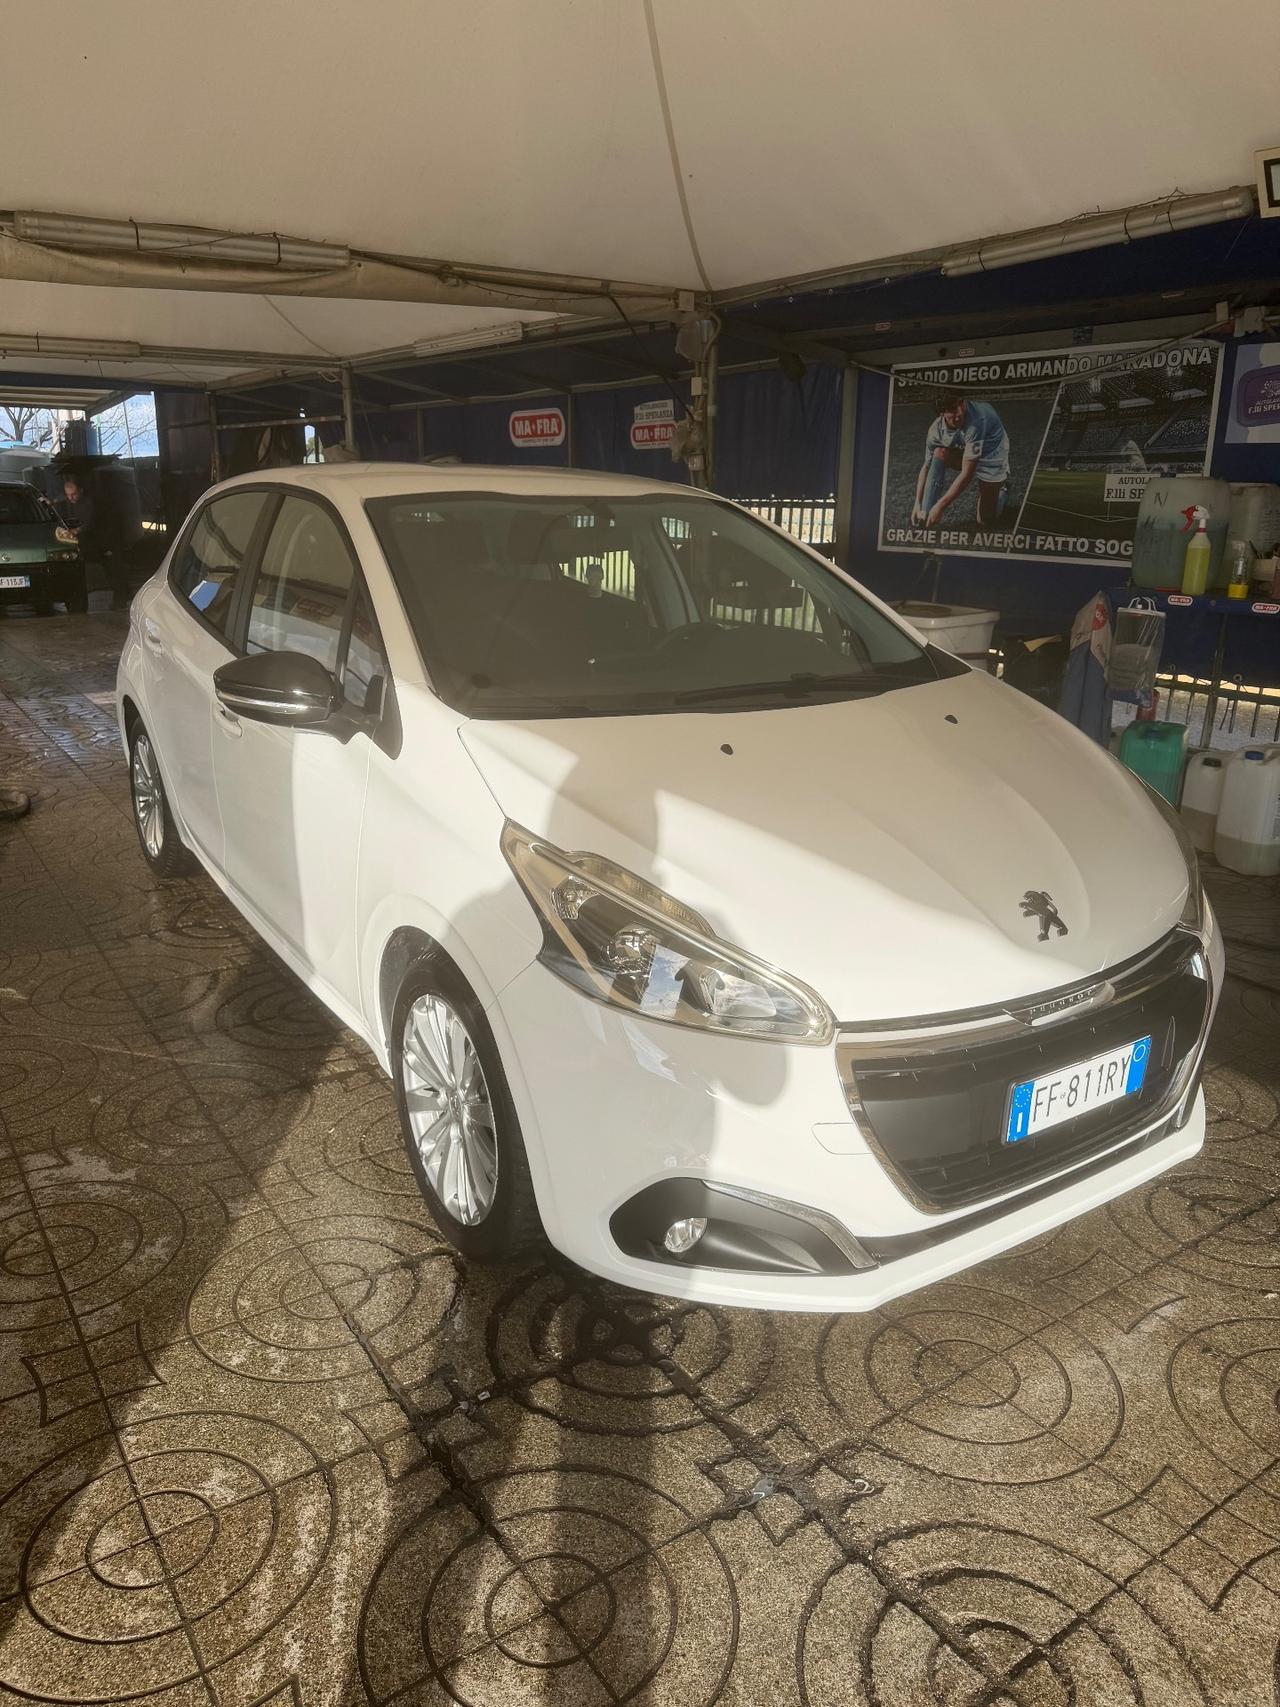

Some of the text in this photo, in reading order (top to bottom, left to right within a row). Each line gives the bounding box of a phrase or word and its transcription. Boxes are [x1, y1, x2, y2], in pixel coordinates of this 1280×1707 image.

[897, 347, 1212, 387] STADIO DIEGO ARMANDO MARADONA
[886, 528, 1135, 556] GRAZIE PER AVERCI FATTO SOG
